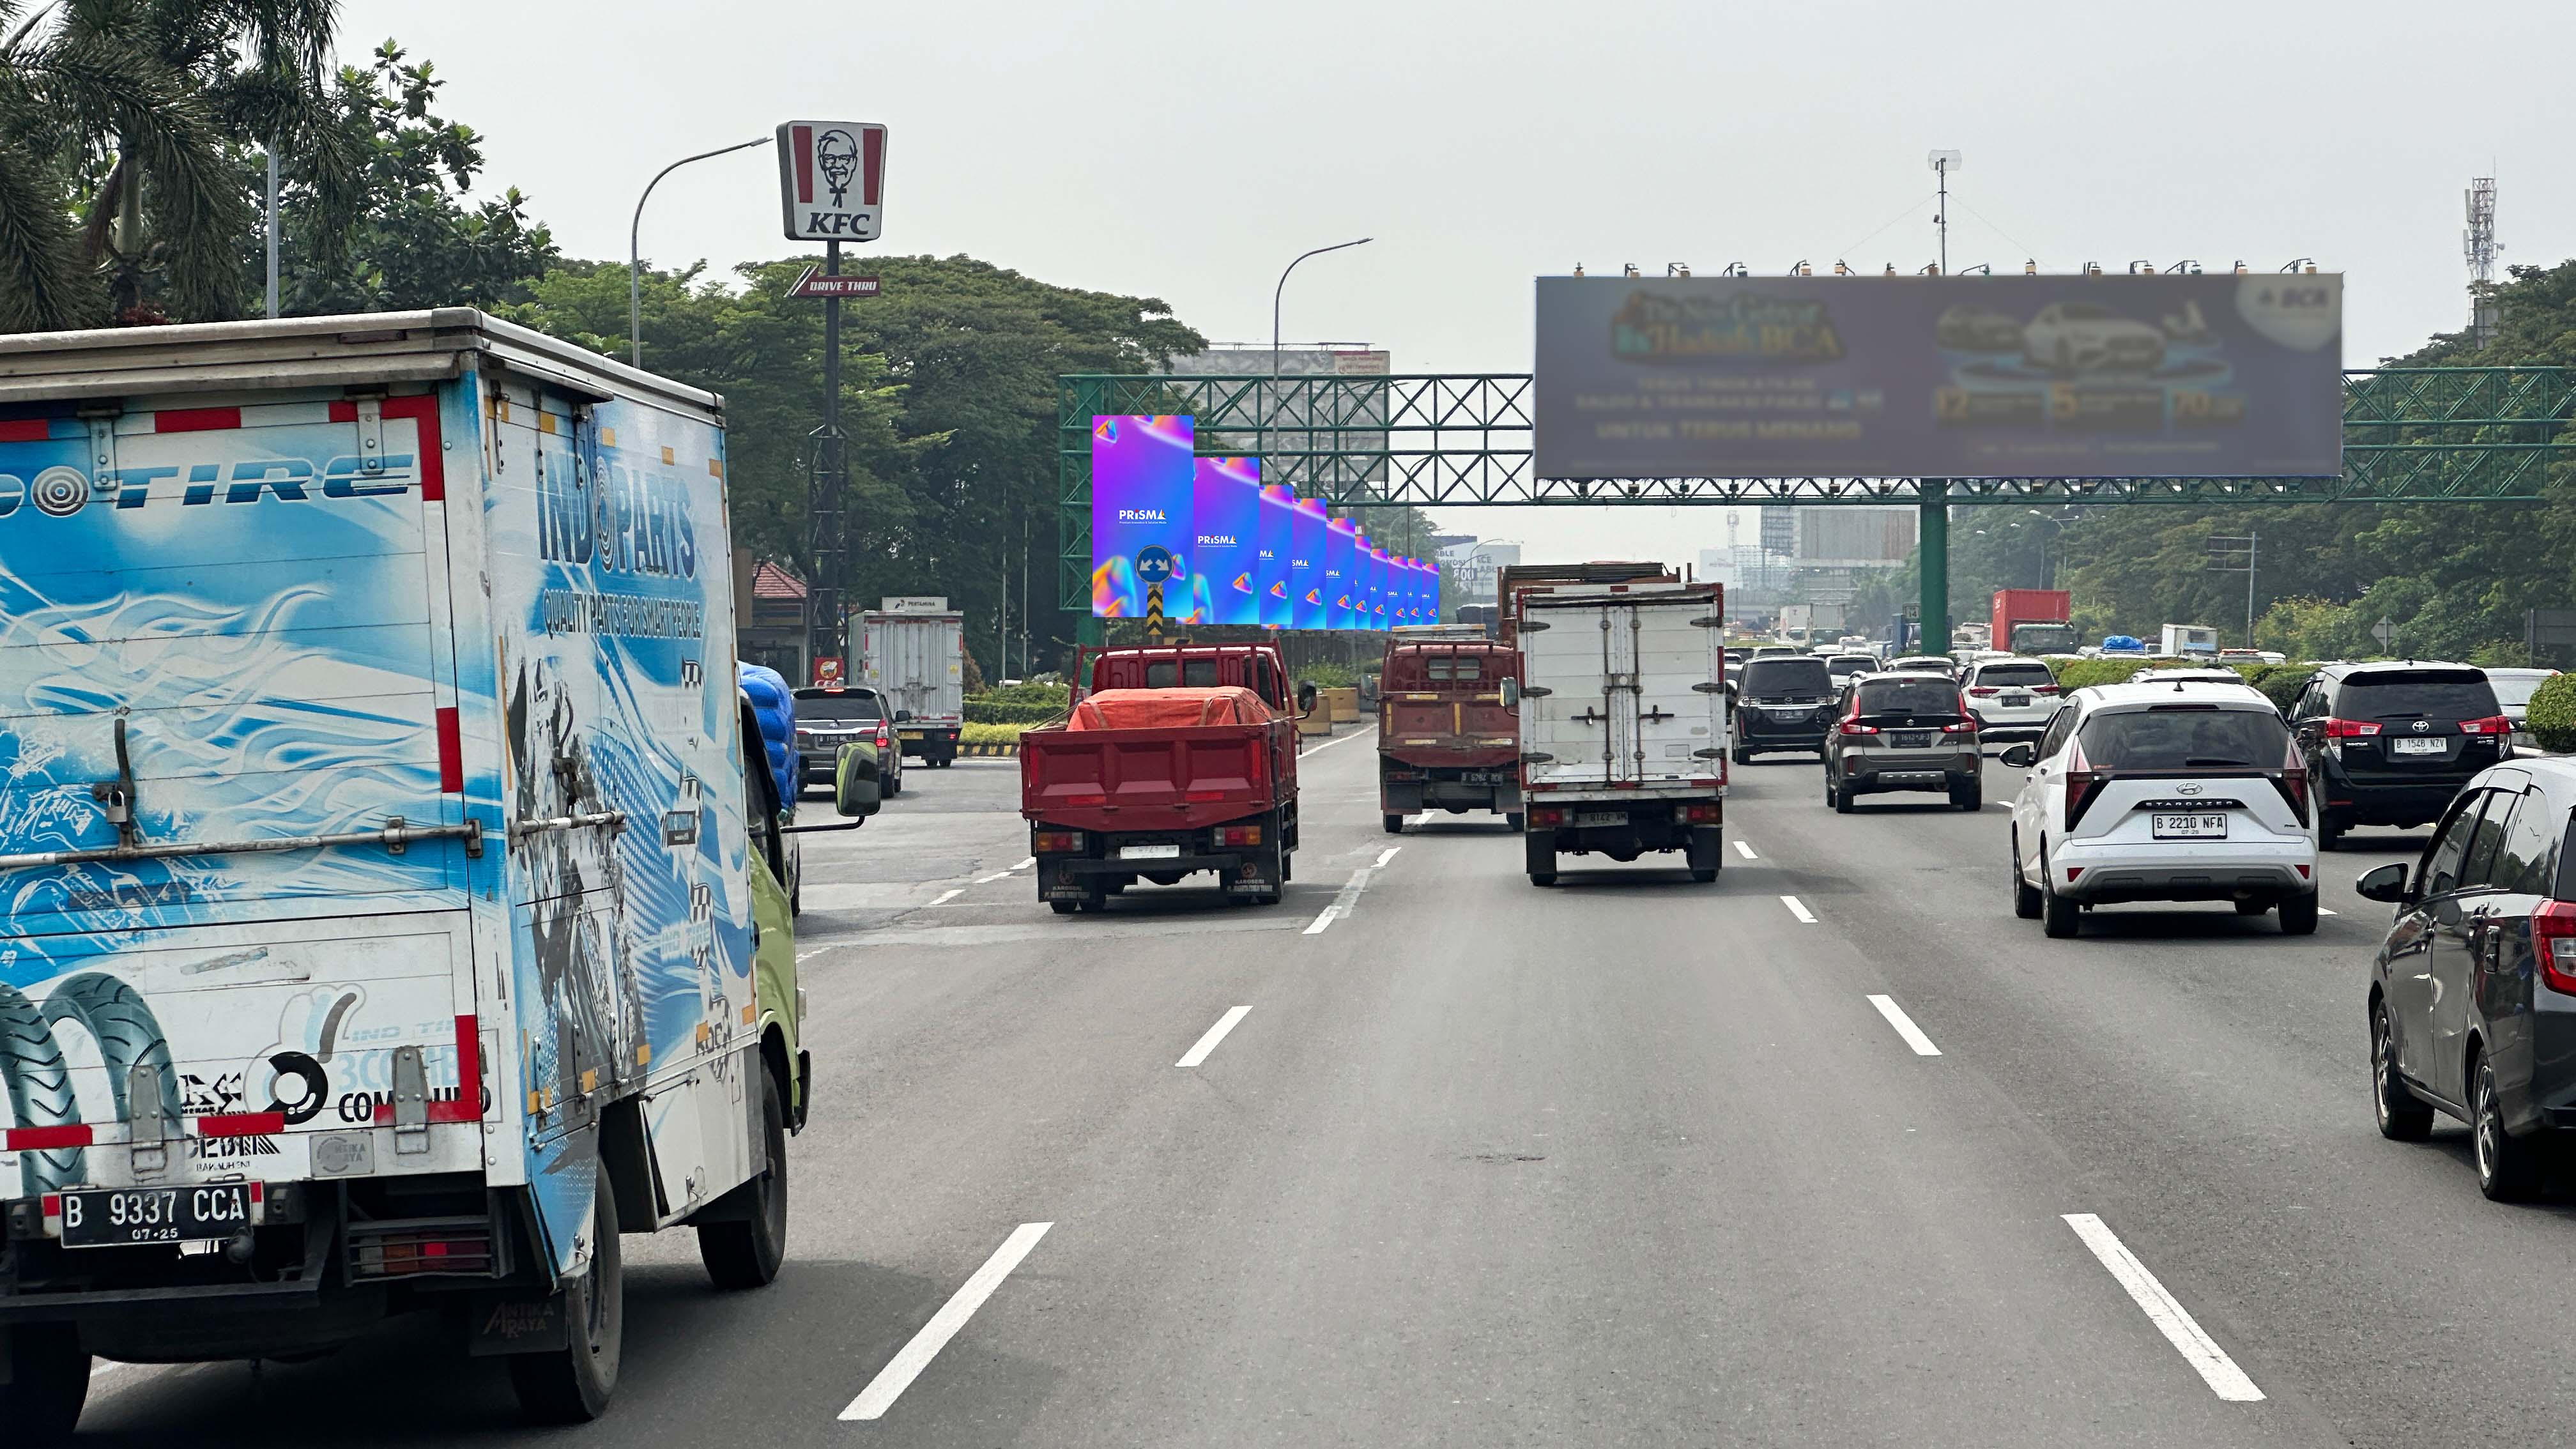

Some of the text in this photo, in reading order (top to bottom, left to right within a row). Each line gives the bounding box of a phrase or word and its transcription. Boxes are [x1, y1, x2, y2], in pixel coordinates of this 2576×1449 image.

[807, 213, 870, 235] KFC
[809, 281, 877, 291] DRIVE THRU
[544, 588, 701, 640] QUALITY PARTS FOR SMART PEOPLE
[2396, 739, 2402, 749] B
[2430, 739, 2444, 747] NZV
[2156, 816, 2223, 829] B 2210 NFA
[66, 1188, 244, 1228] B 9337 CCA
